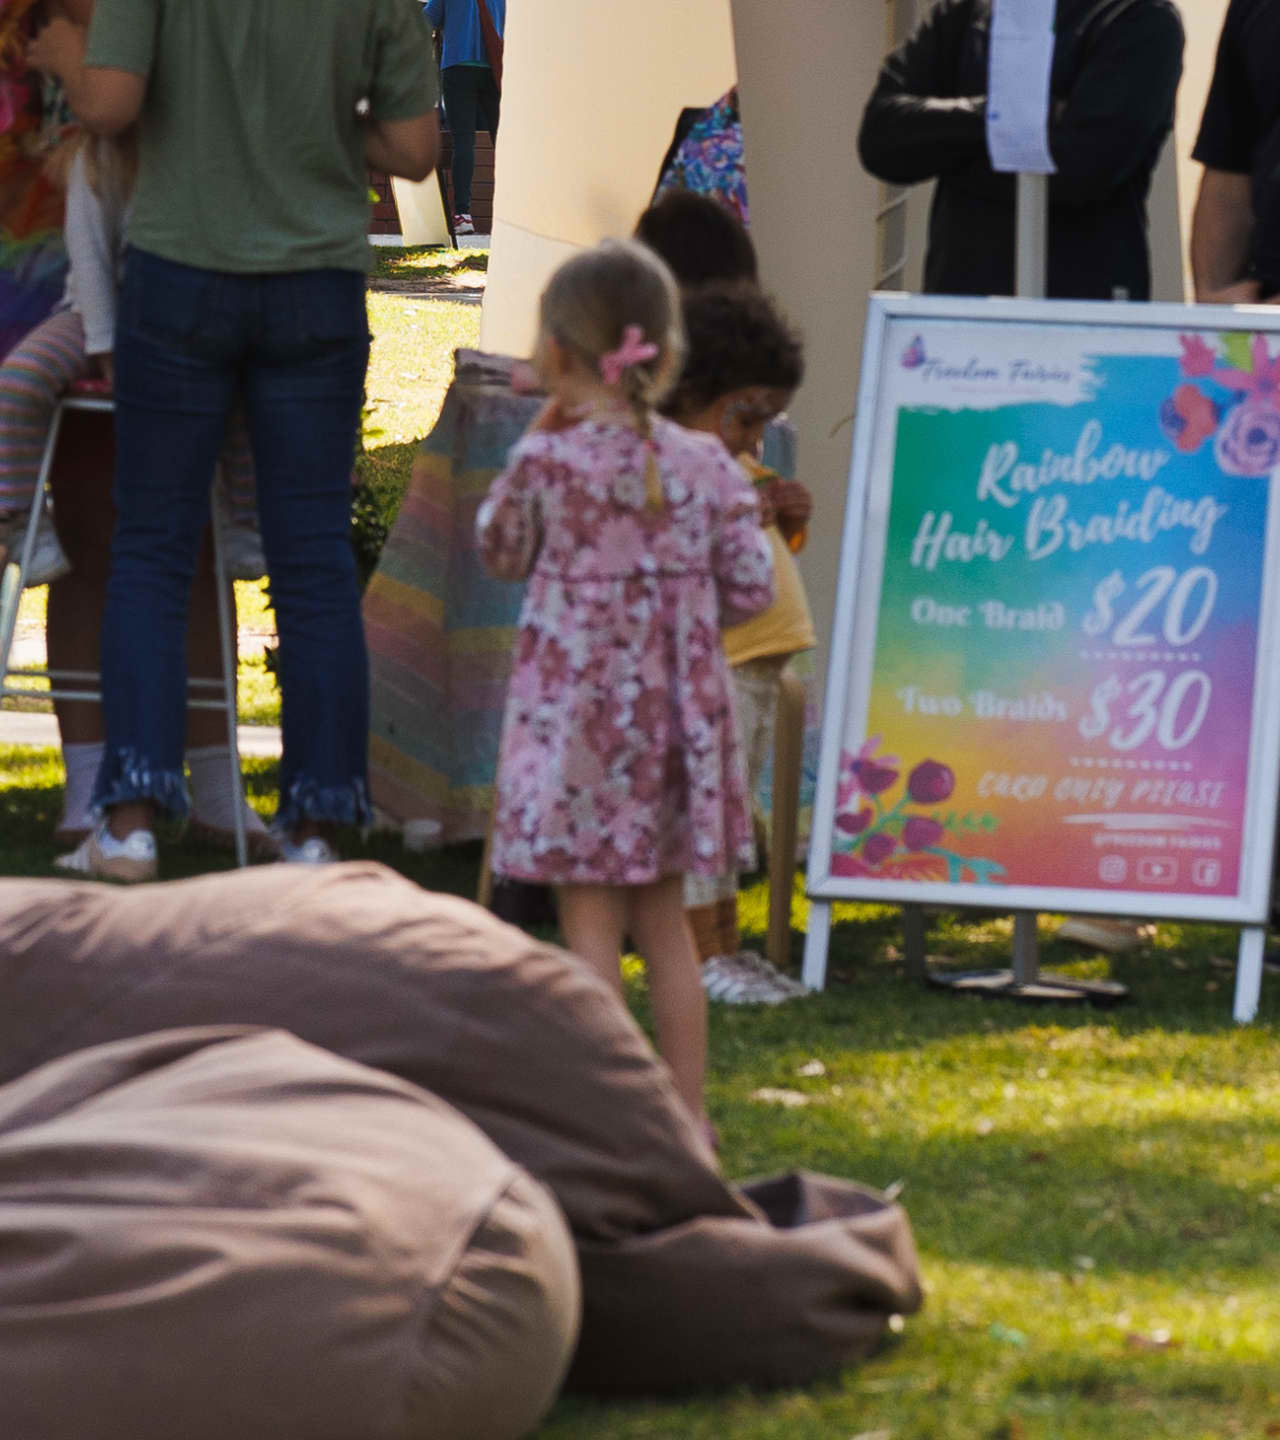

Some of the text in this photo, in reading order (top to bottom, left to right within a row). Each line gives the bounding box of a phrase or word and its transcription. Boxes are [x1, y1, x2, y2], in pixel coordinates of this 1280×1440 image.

[977, 418, 1170, 508] Rainbow
[910, 486, 1229, 572] Hair Braiding
[910, 565, 1219, 647] One Braid $20
[896, 669, 1213, 752] Two Braids $30
